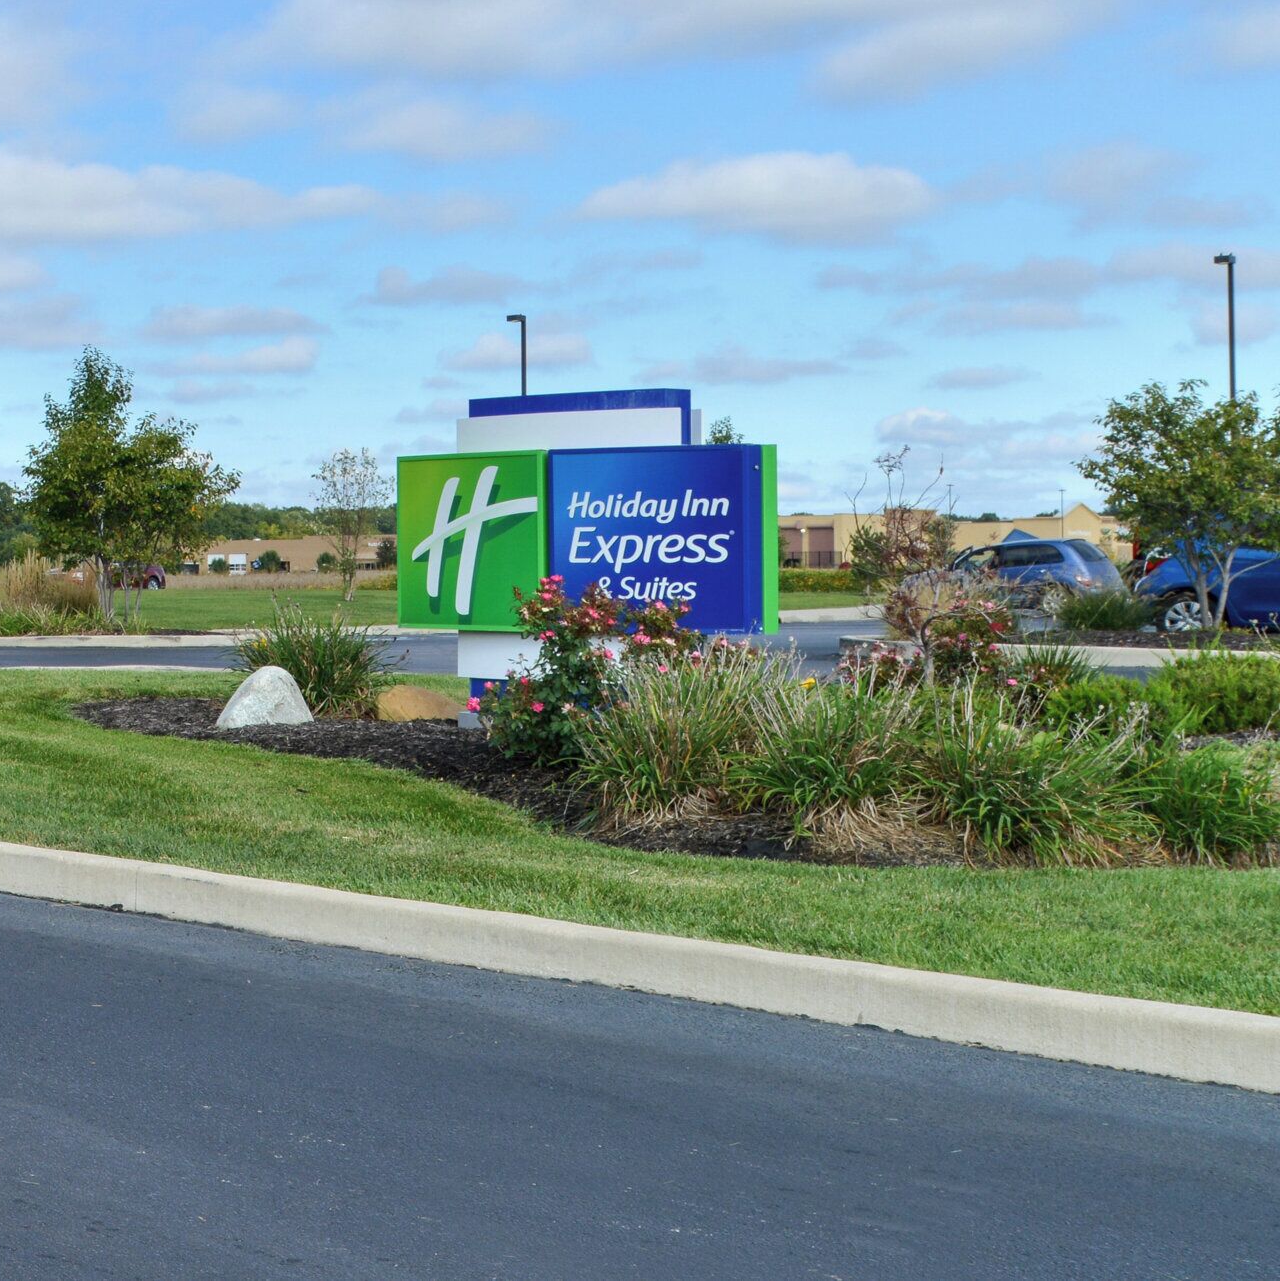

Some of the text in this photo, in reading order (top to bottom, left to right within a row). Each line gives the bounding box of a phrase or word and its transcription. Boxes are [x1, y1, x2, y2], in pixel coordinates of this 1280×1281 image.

[567, 489, 730, 523] Holiday Inn
[568, 526, 731, 573] Express
[598, 576, 697, 602] & Suites
